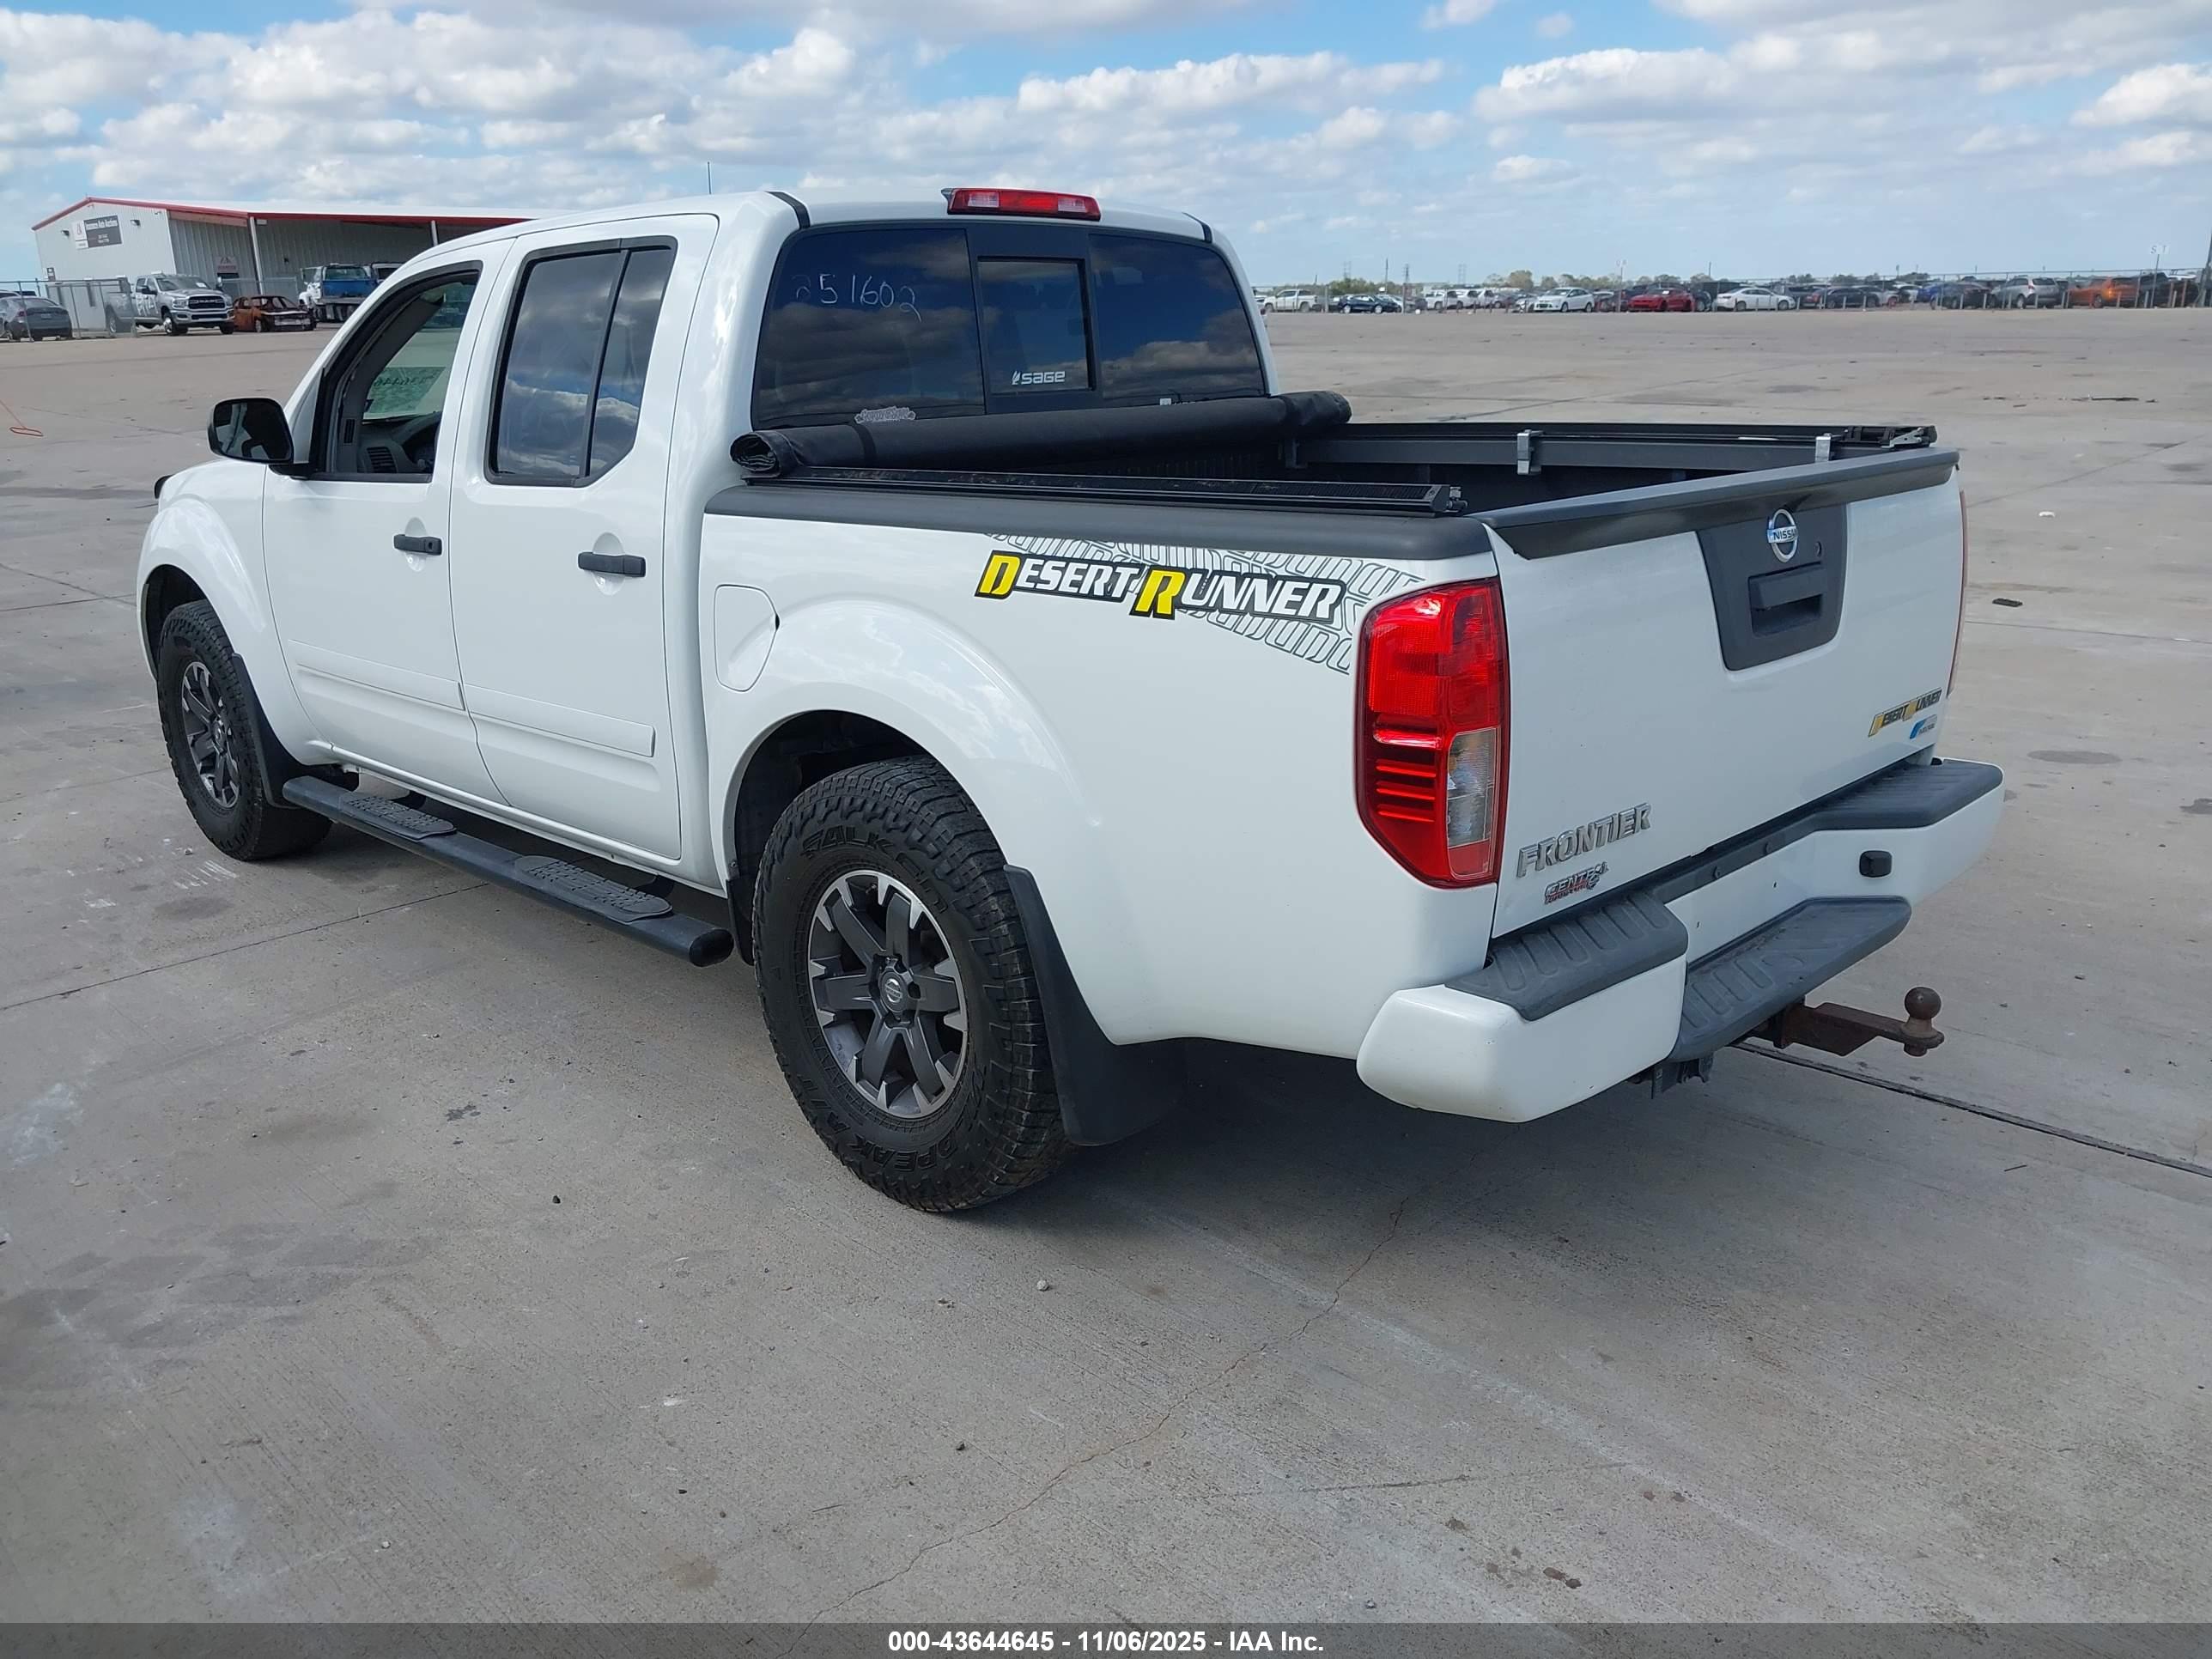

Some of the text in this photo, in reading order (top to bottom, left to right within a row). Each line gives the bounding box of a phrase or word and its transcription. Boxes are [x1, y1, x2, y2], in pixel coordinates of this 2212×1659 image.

[976, 552, 1344, 619] DESERT RUNNER
[1516, 802, 1651, 878] FRONTIER
